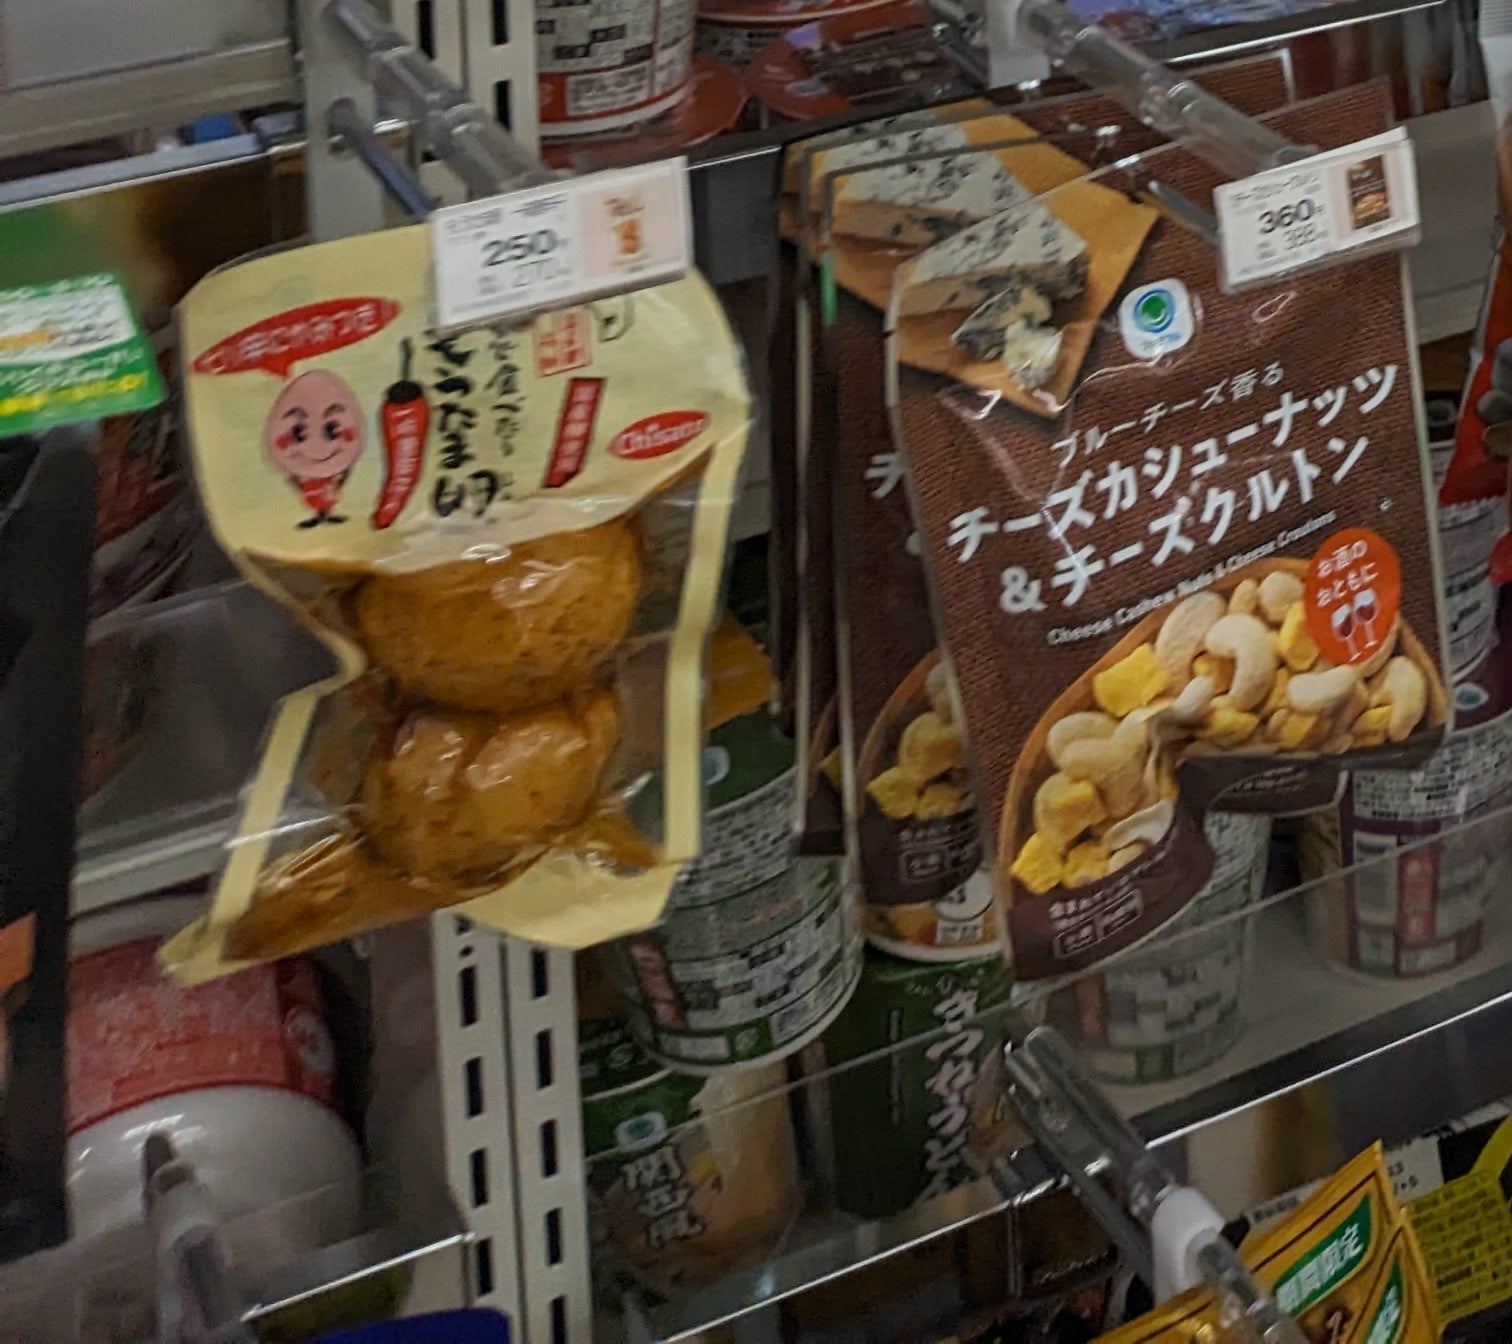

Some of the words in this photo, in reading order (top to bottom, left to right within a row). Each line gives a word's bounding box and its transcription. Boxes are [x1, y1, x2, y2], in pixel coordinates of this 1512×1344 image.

[1258, 197, 1316, 234] 360
[481, 228, 558, 268] 250
[1051, 360, 1285, 469] ブルーチーズ香る
[947, 363, 1399, 563] チーズカシューナッツ
[1317, 538, 1369, 579] お酒の
[1047, 616, 1113, 646] Cheese
[1227, 540, 1277, 573] Cheese
[1316, 560, 1380, 608] おともに
